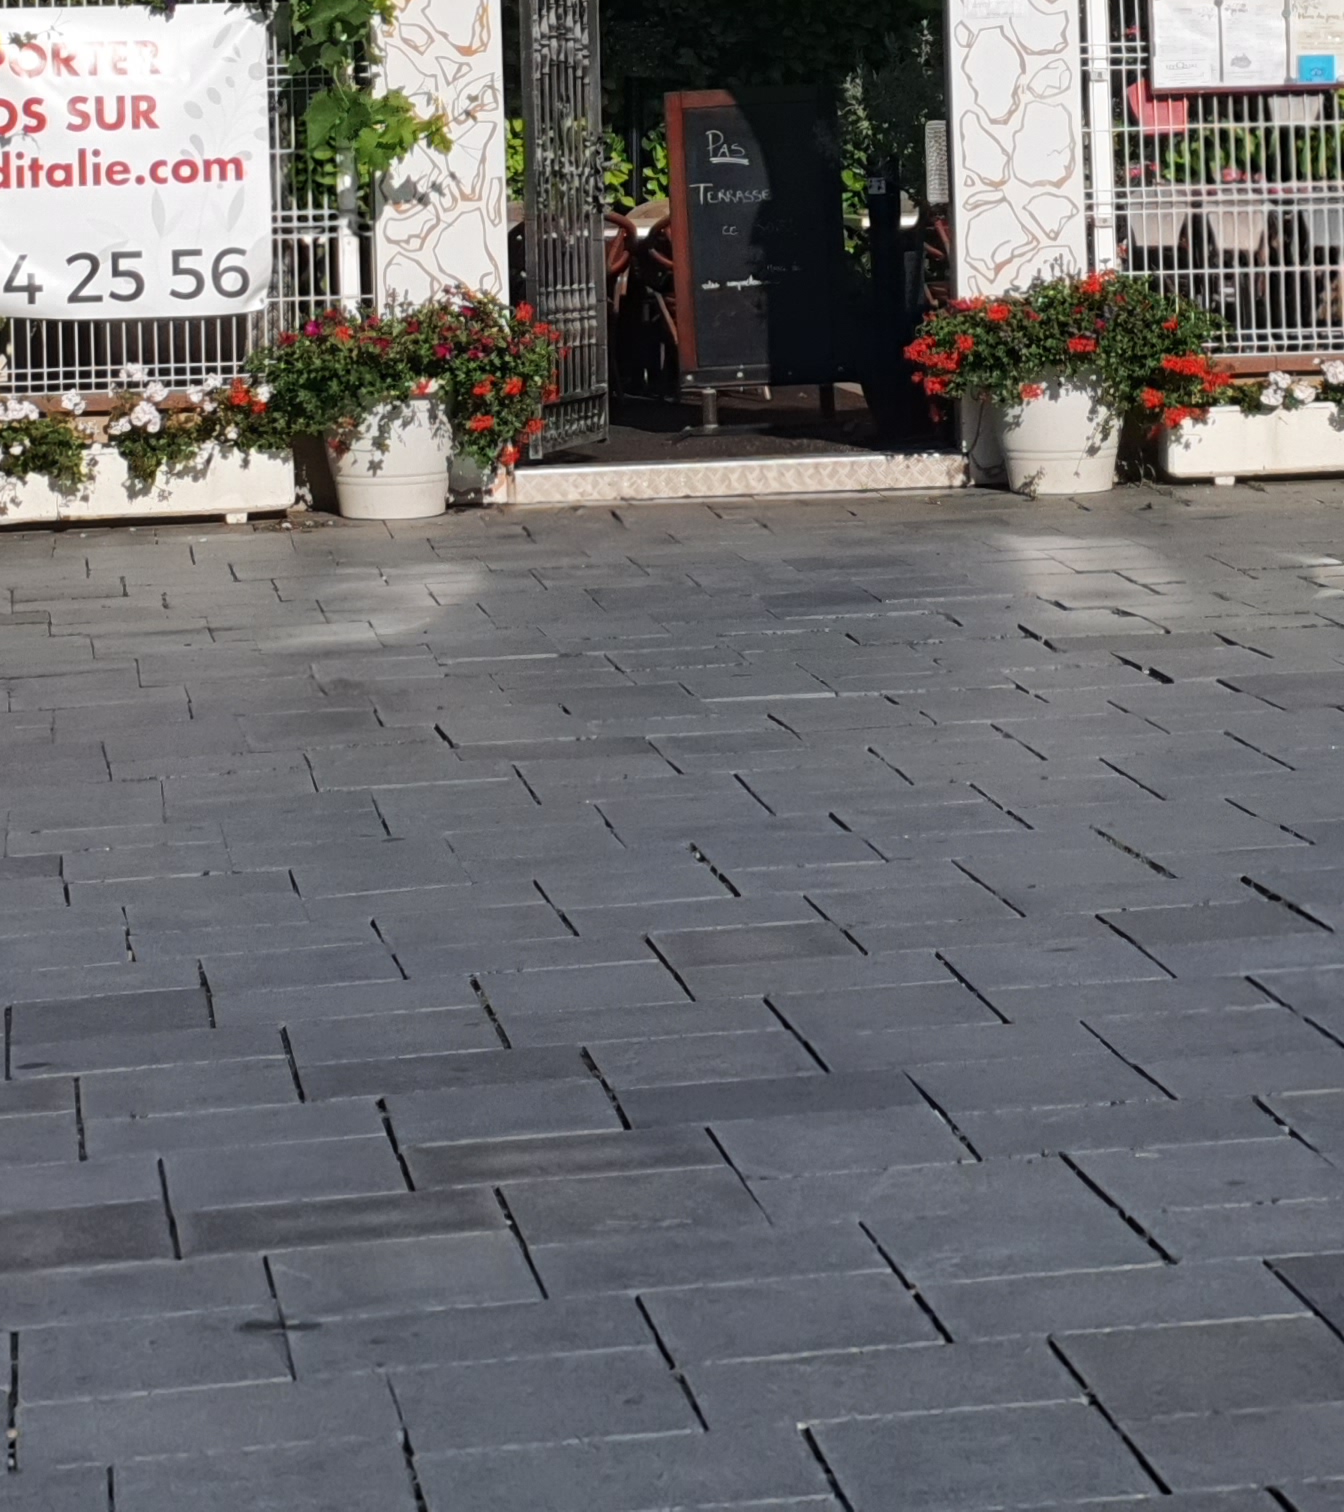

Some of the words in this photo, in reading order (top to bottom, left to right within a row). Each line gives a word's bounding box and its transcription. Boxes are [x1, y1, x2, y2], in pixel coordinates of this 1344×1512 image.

[66, 94, 161, 133] SUR
[65, 249, 146, 304] 25
[169, 246, 251, 300] 56
